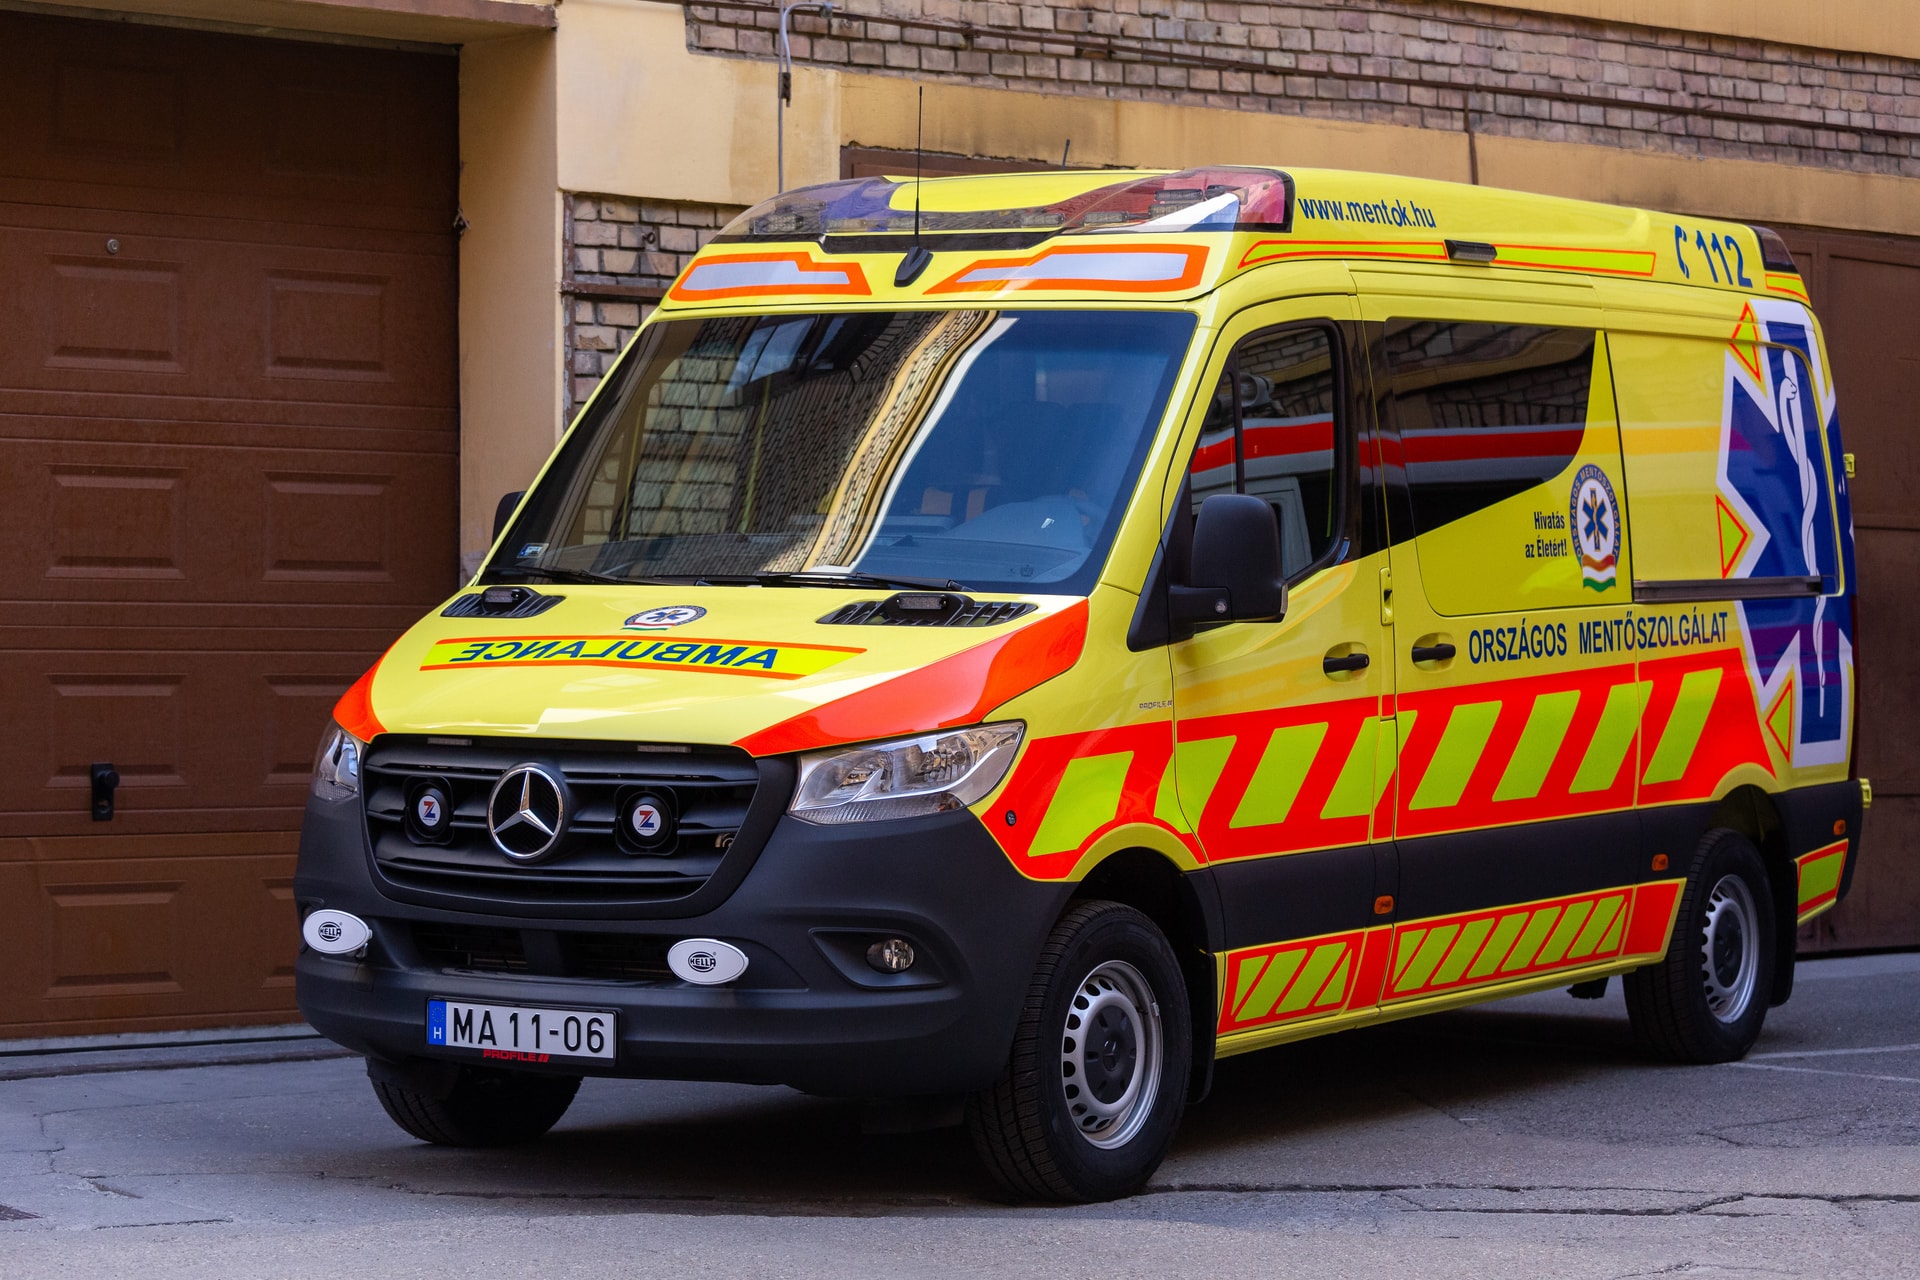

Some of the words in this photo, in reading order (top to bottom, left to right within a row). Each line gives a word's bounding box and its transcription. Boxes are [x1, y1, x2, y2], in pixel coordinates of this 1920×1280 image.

[1297, 197, 1437, 229] www.mentok.hu
[1696, 230, 1754, 288] 112
[1534, 511, 1565, 530] Hivatás
[1525, 544, 1535, 558] az
[1537, 535, 1568, 558] Életért!
[1468, 618, 1567, 664] ORSZÁGOS
[1579, 606, 1728, 654] MENTŐSZOLGÁLAT
[433, 1027, 442, 1040] H
[453, 1007, 497, 1046] MA
[509, 1012, 605, 1053] 11-06
[482, 1049, 537, 1062] PROFILE
